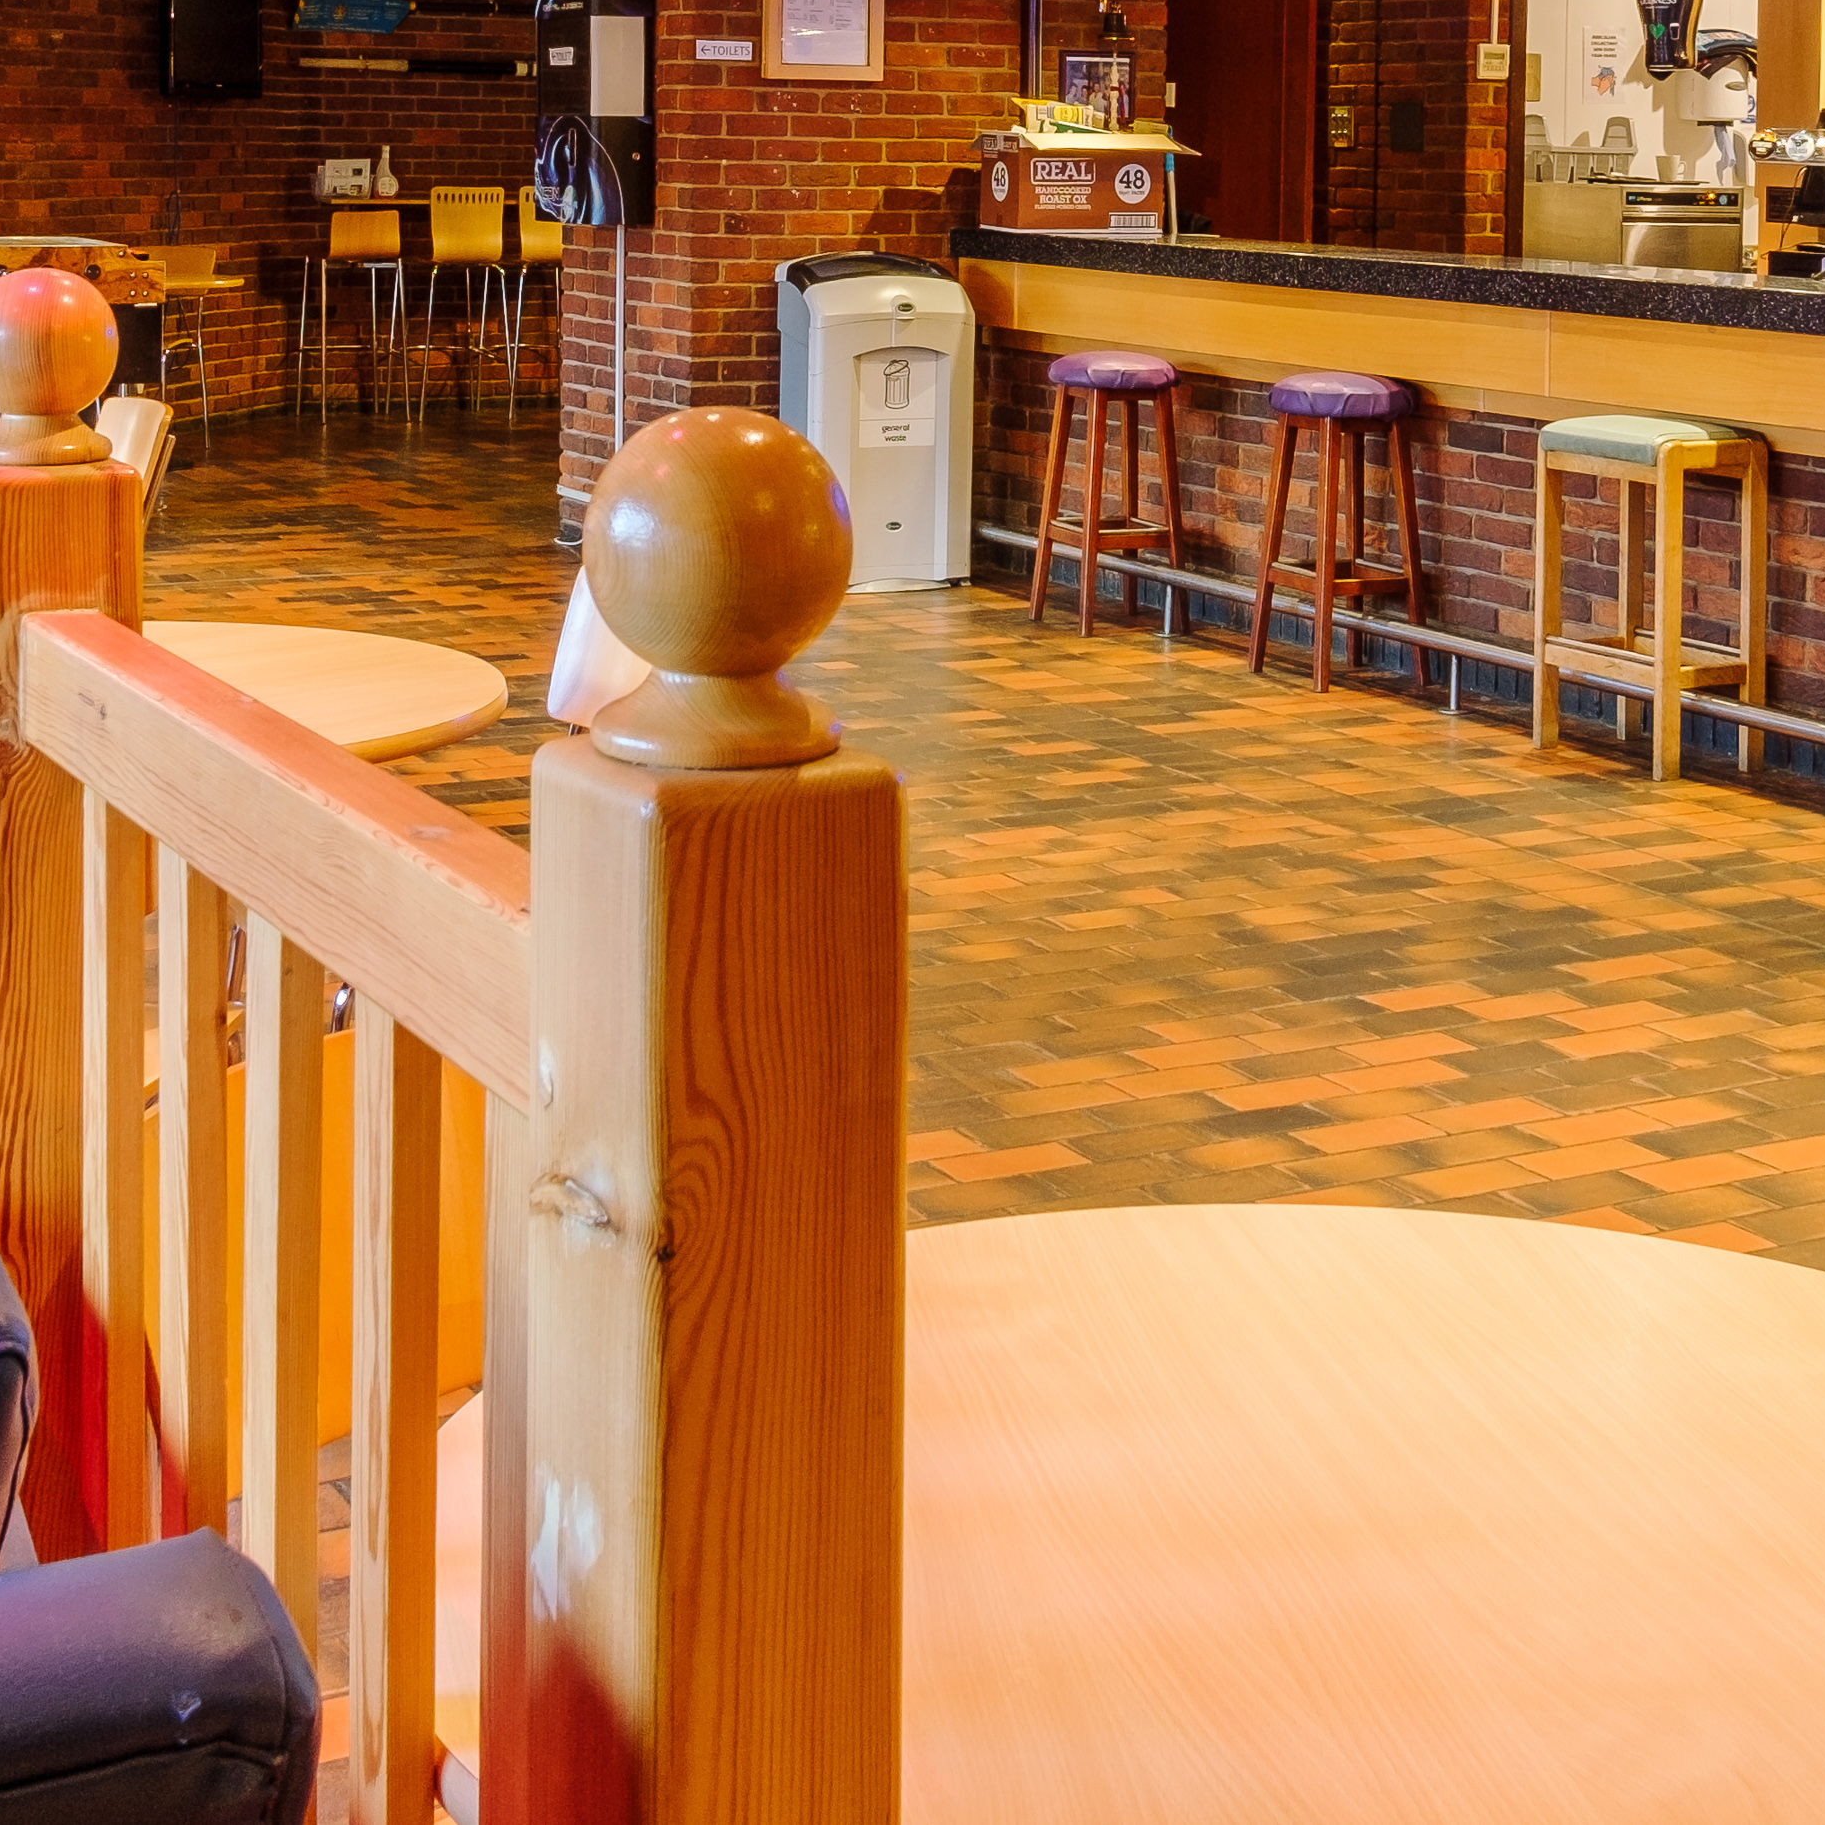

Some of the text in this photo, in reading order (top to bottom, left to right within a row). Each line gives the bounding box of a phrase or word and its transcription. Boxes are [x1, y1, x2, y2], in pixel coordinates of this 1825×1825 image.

[711, 45, 751, 56] TOILETS
[1035, 161, 1092, 180] REAL
[994, 167, 1006, 187] 48
[1118, 169, 1145, 189] 48
[1035, 186, 1092, 194] HANDCOOKED
[1039, 195, 1088, 204] ROAST OX
[882, 424, 910, 434] general
